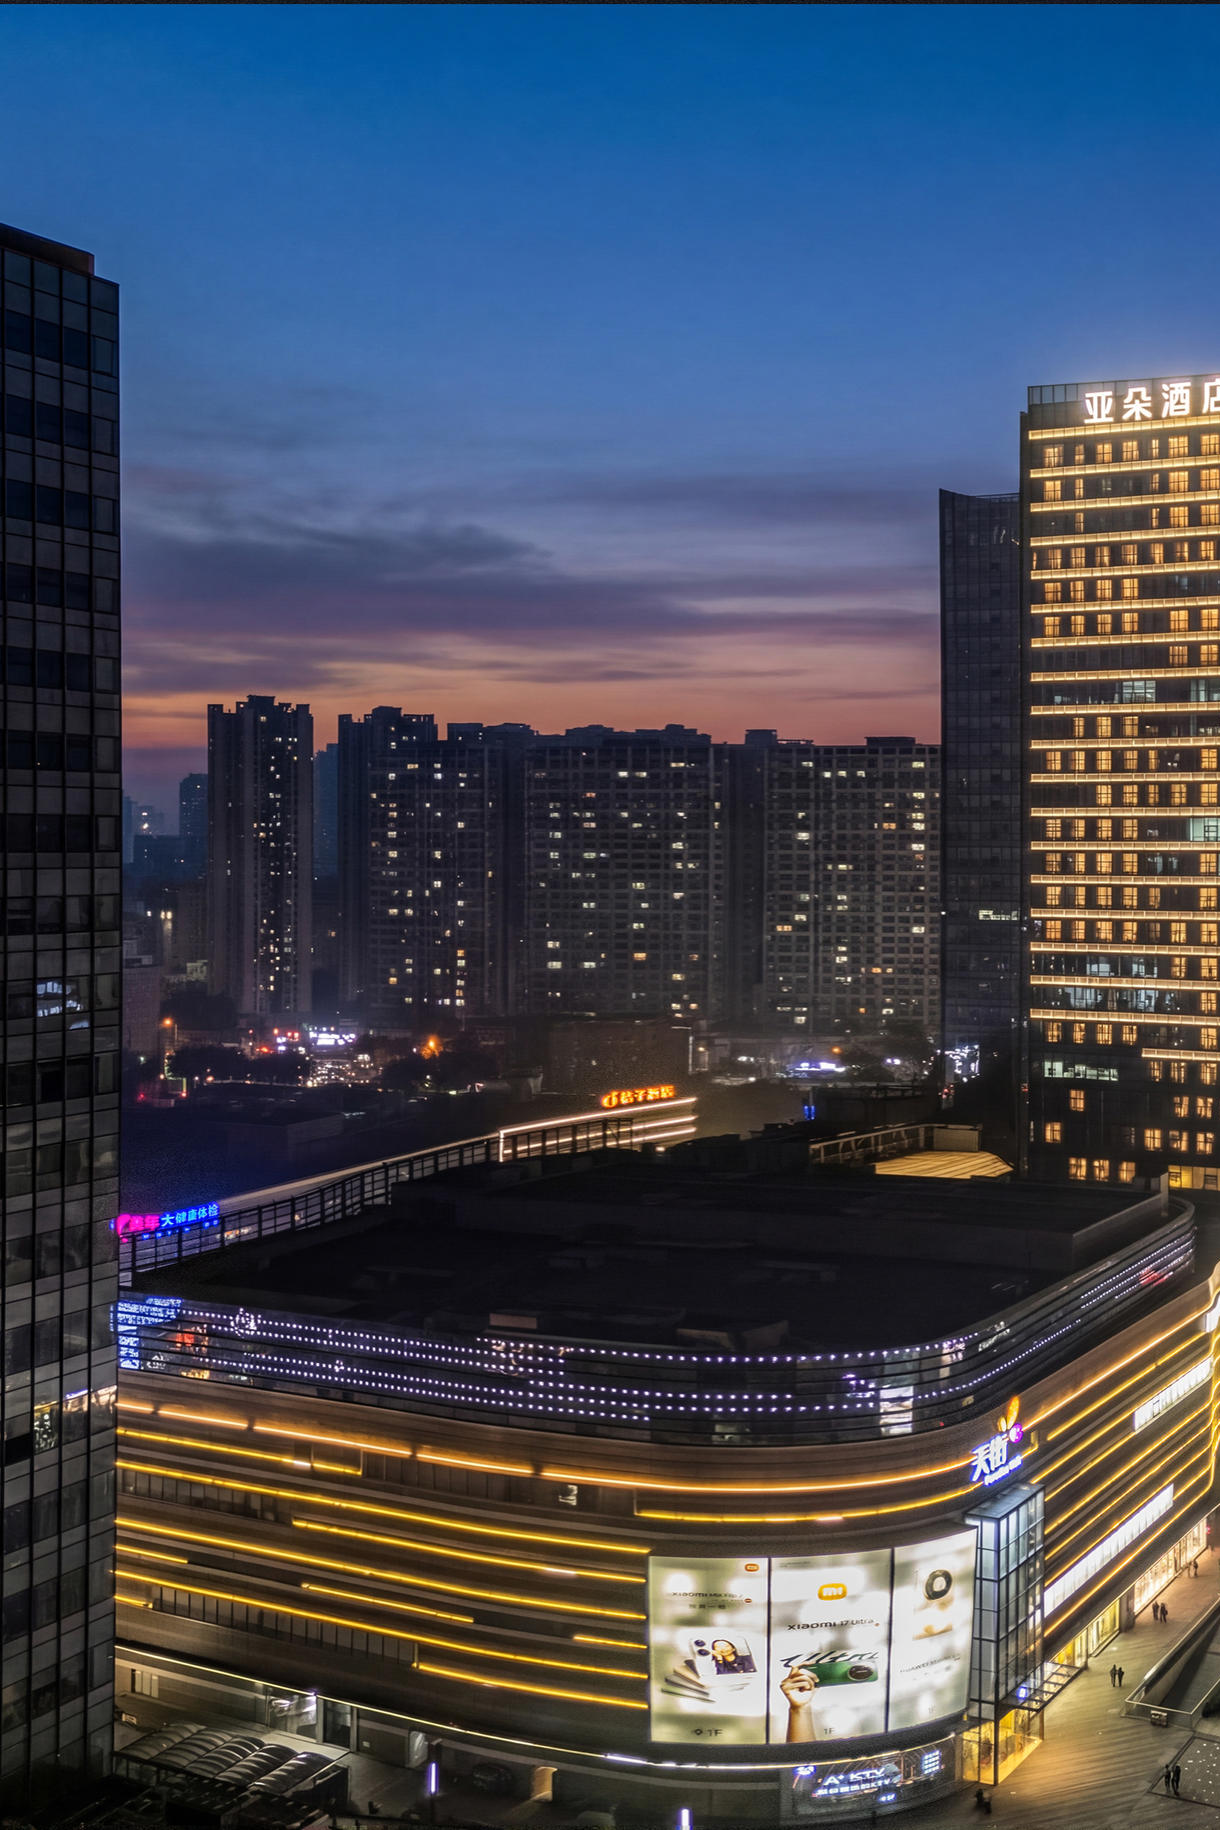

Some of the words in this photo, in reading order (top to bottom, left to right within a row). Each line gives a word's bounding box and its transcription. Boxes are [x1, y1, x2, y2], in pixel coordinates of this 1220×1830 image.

[970, 1433, 1009, 1482] 天街
[786, 1621, 837, 1632] xiaomi
[708, 1728, 724, 1737] 1F
